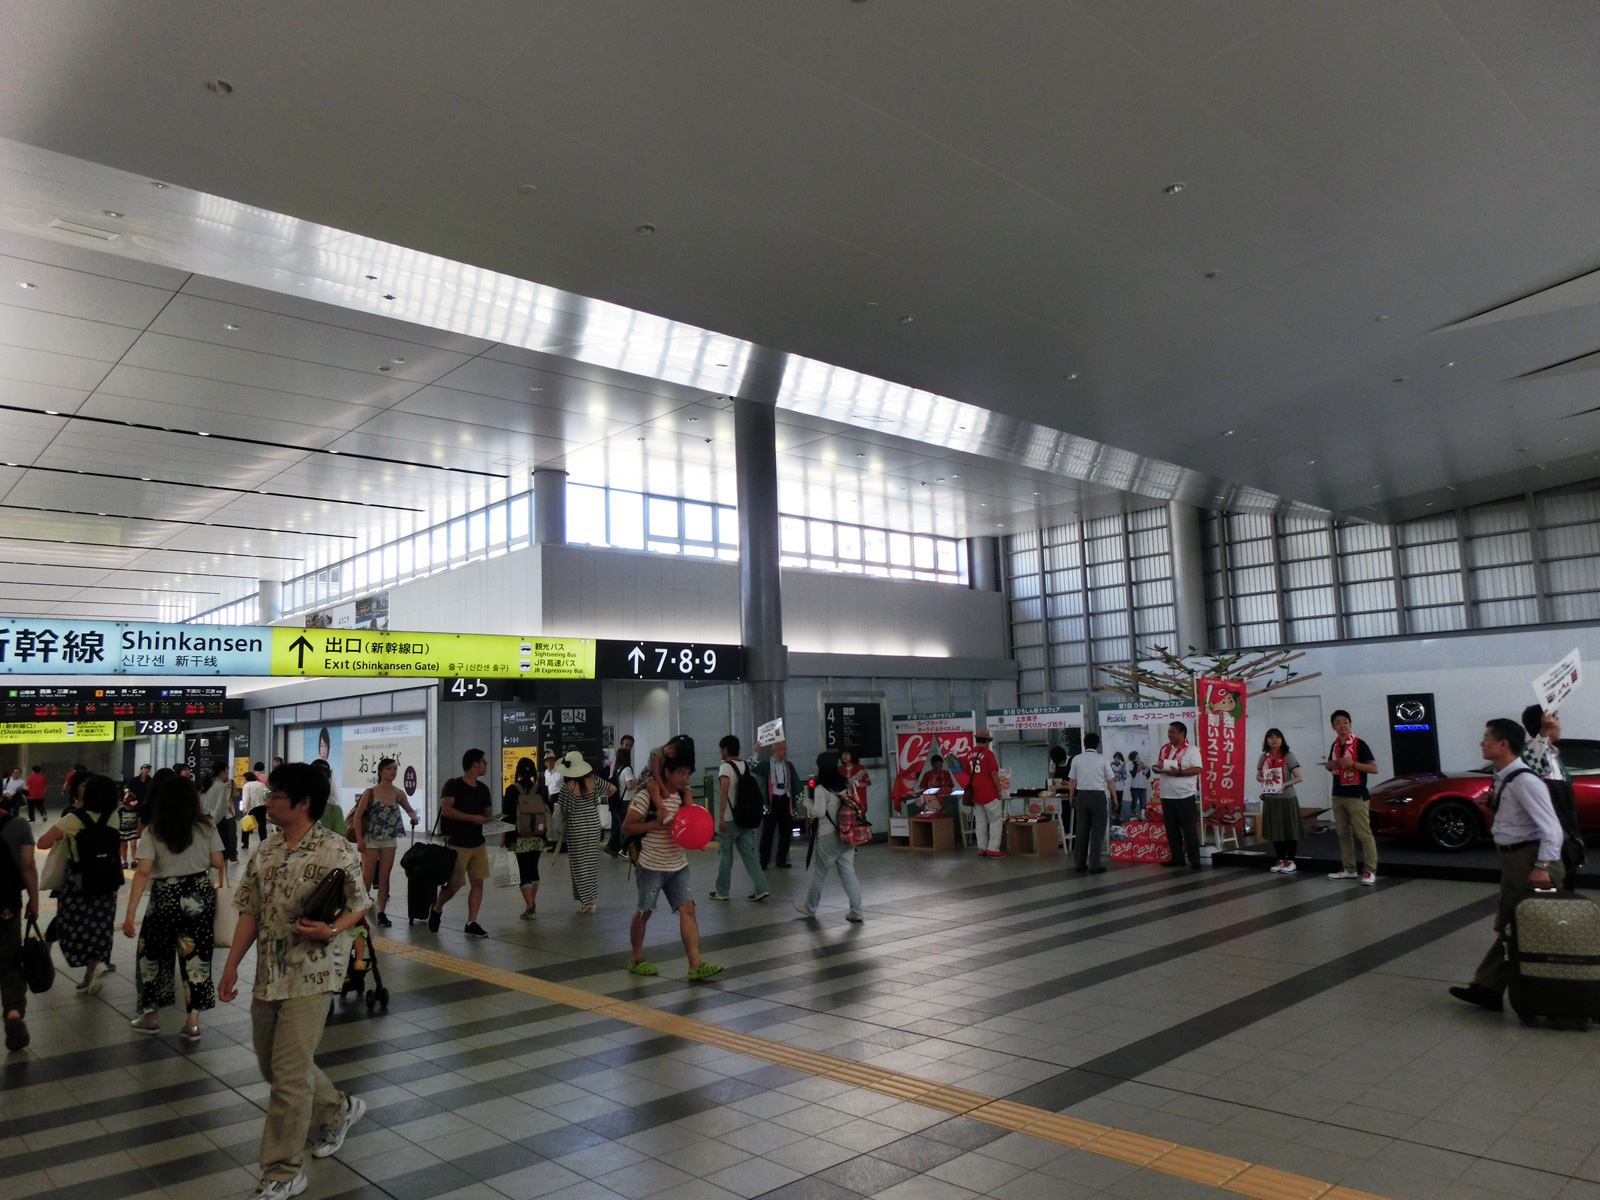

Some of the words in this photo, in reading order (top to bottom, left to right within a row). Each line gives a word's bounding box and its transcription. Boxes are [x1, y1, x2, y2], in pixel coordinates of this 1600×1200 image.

[0, 629, 104, 663] 幹線
[122, 631, 262, 655] Shinkansen
[535, 643, 565, 651] 観光バス
[122, 655, 165, 667] 신칸센
[175, 655, 218, 668] 新干线
[325, 659, 350, 670] Exit
[353, 661, 412, 672] (Shinkansen
[415, 661, 440, 672] Gate)
[1222, 711, 1235, 789] 強いカープの
[1149, 825, 1166, 839] Car
[1110, 842, 1133, 857] Carp
[1133, 843, 1156, 858] Carp
[1156, 846, 1170, 859] Ca
